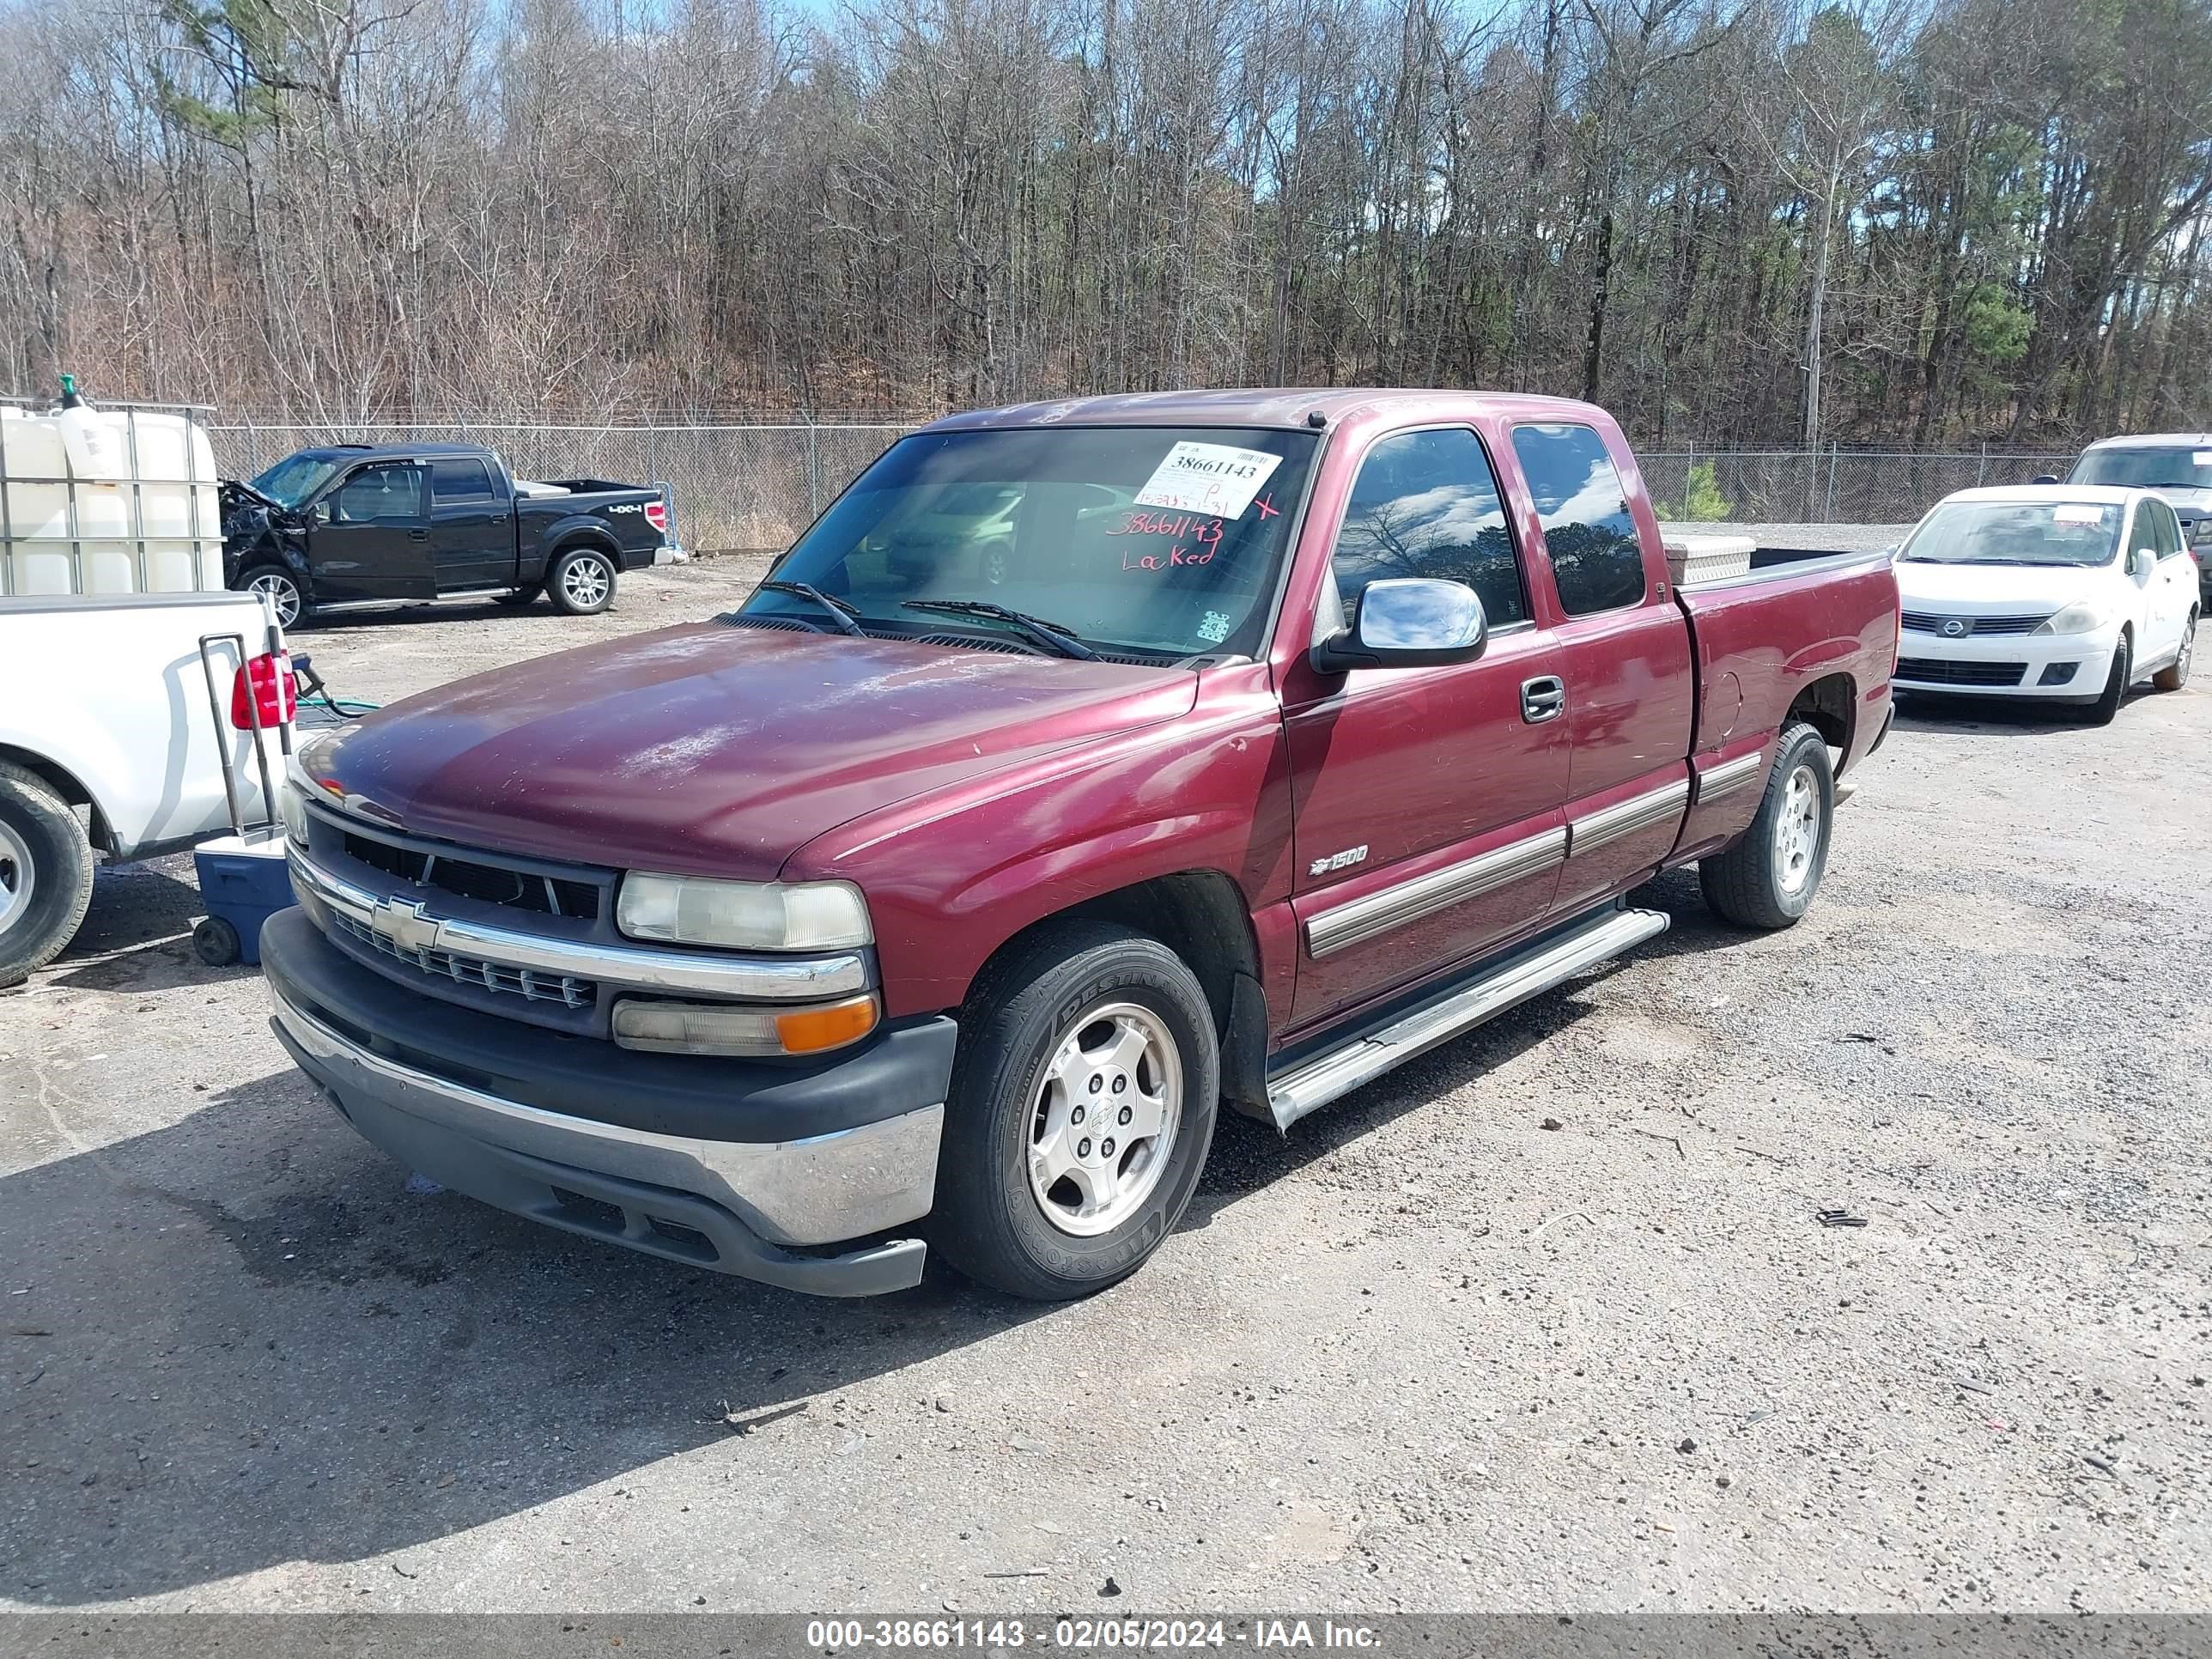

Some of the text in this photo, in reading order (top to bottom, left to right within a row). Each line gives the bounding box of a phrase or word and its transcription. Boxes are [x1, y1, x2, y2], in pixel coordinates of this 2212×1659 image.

[1170, 456, 1257, 478] 38661143
[1106, 512, 1224, 543] 38661143
[1331, 844, 1368, 870] 1500
[1060, 971, 1209, 1060] DESTINATION
